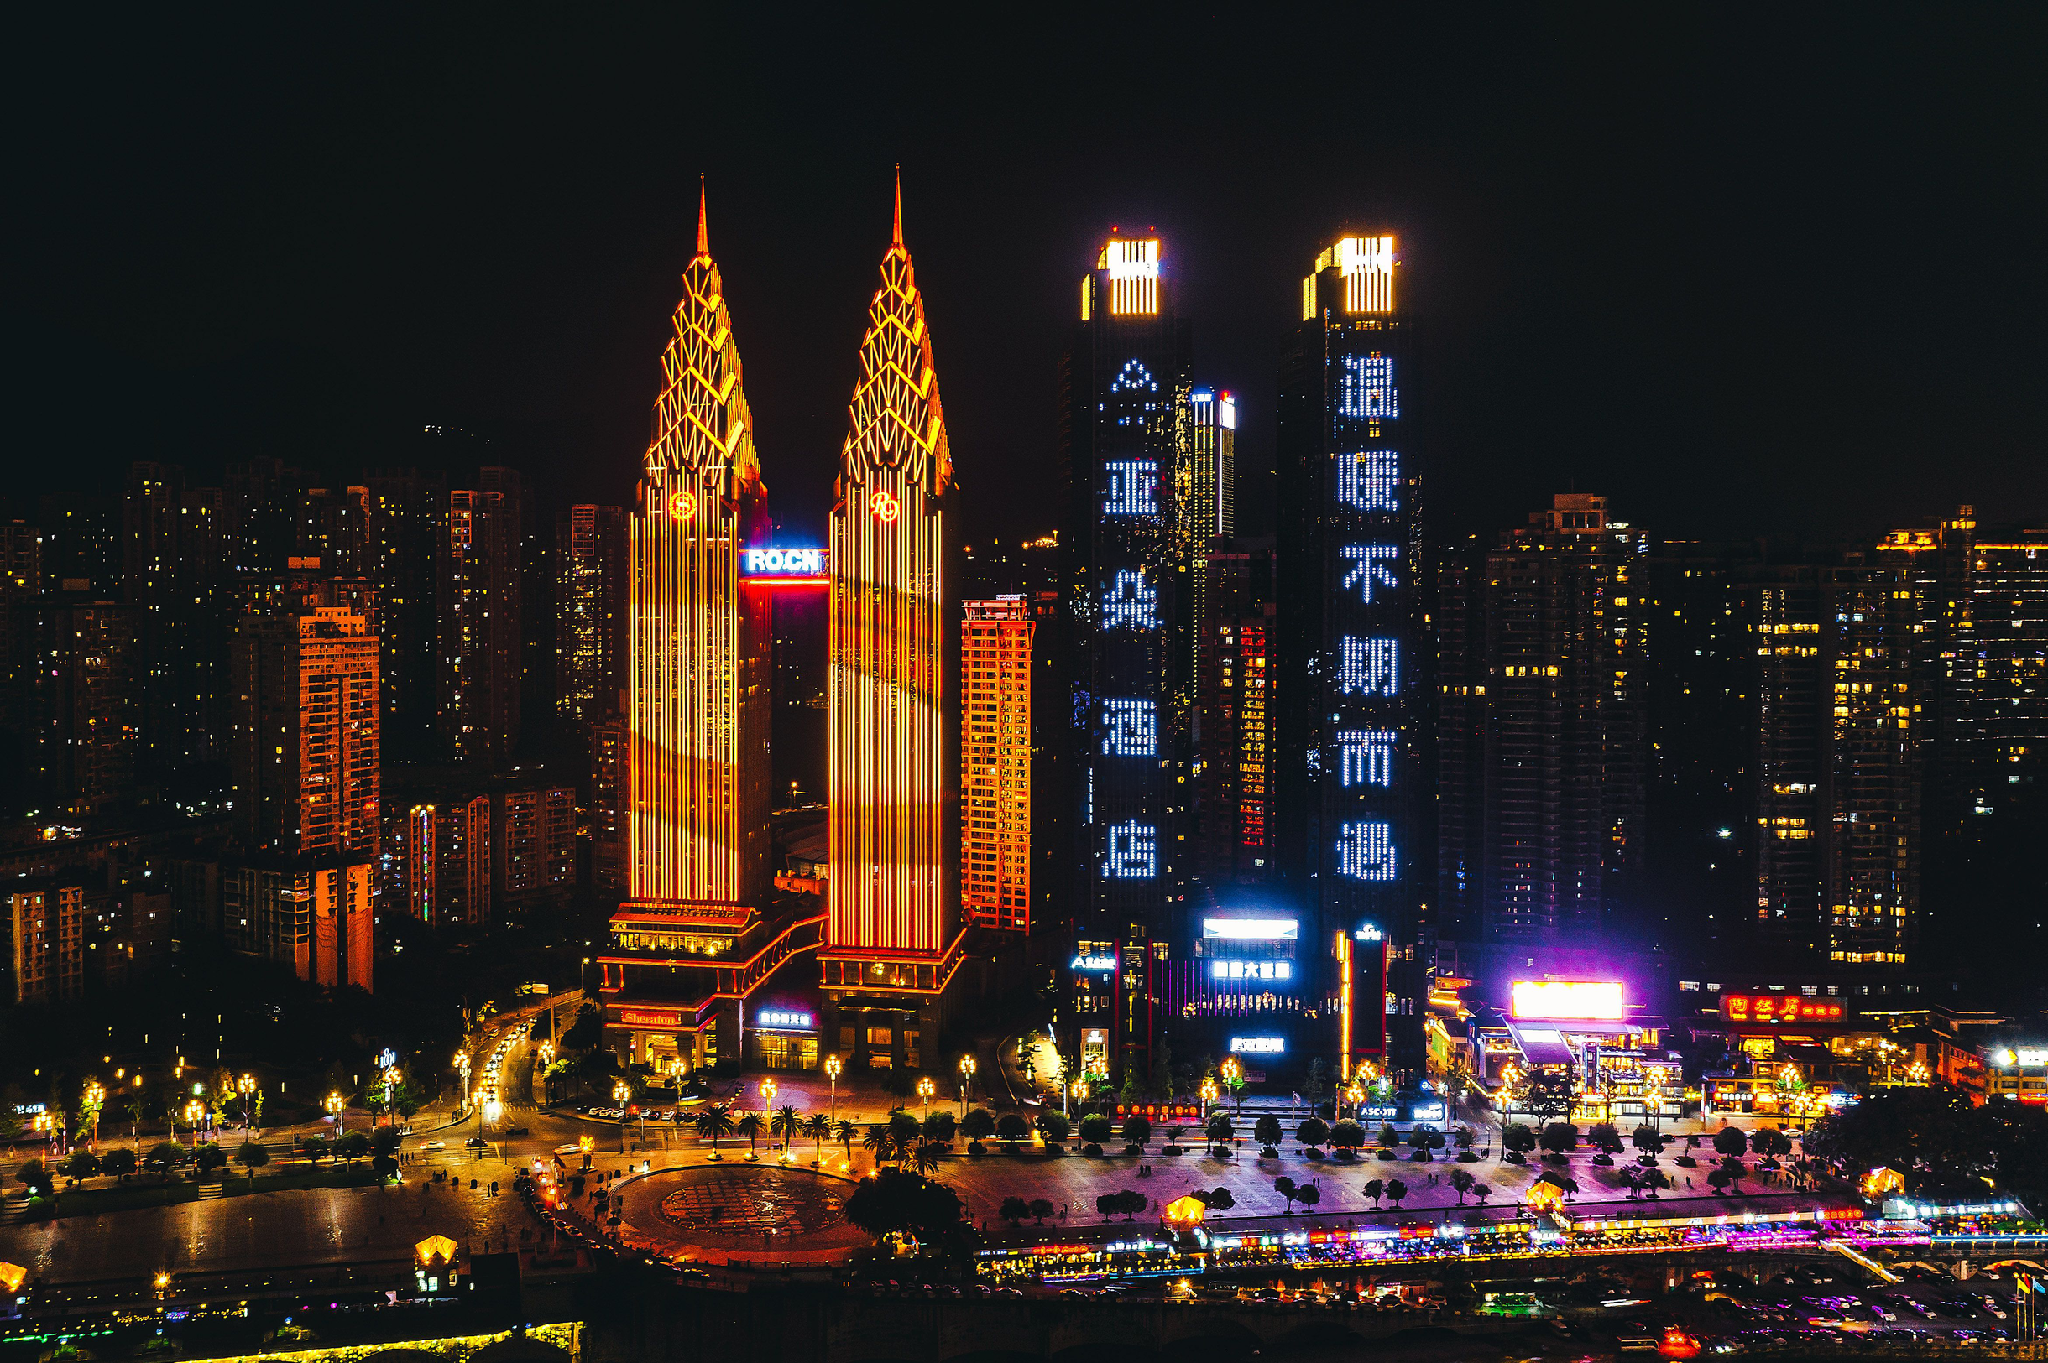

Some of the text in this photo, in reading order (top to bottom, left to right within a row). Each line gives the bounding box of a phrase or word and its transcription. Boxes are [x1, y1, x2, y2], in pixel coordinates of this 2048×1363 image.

[748, 549, 820, 572] RO.CN
[1101, 460, 1159, 878] 亚朵酒店
[622, 1012, 676, 1026] Sheraton
